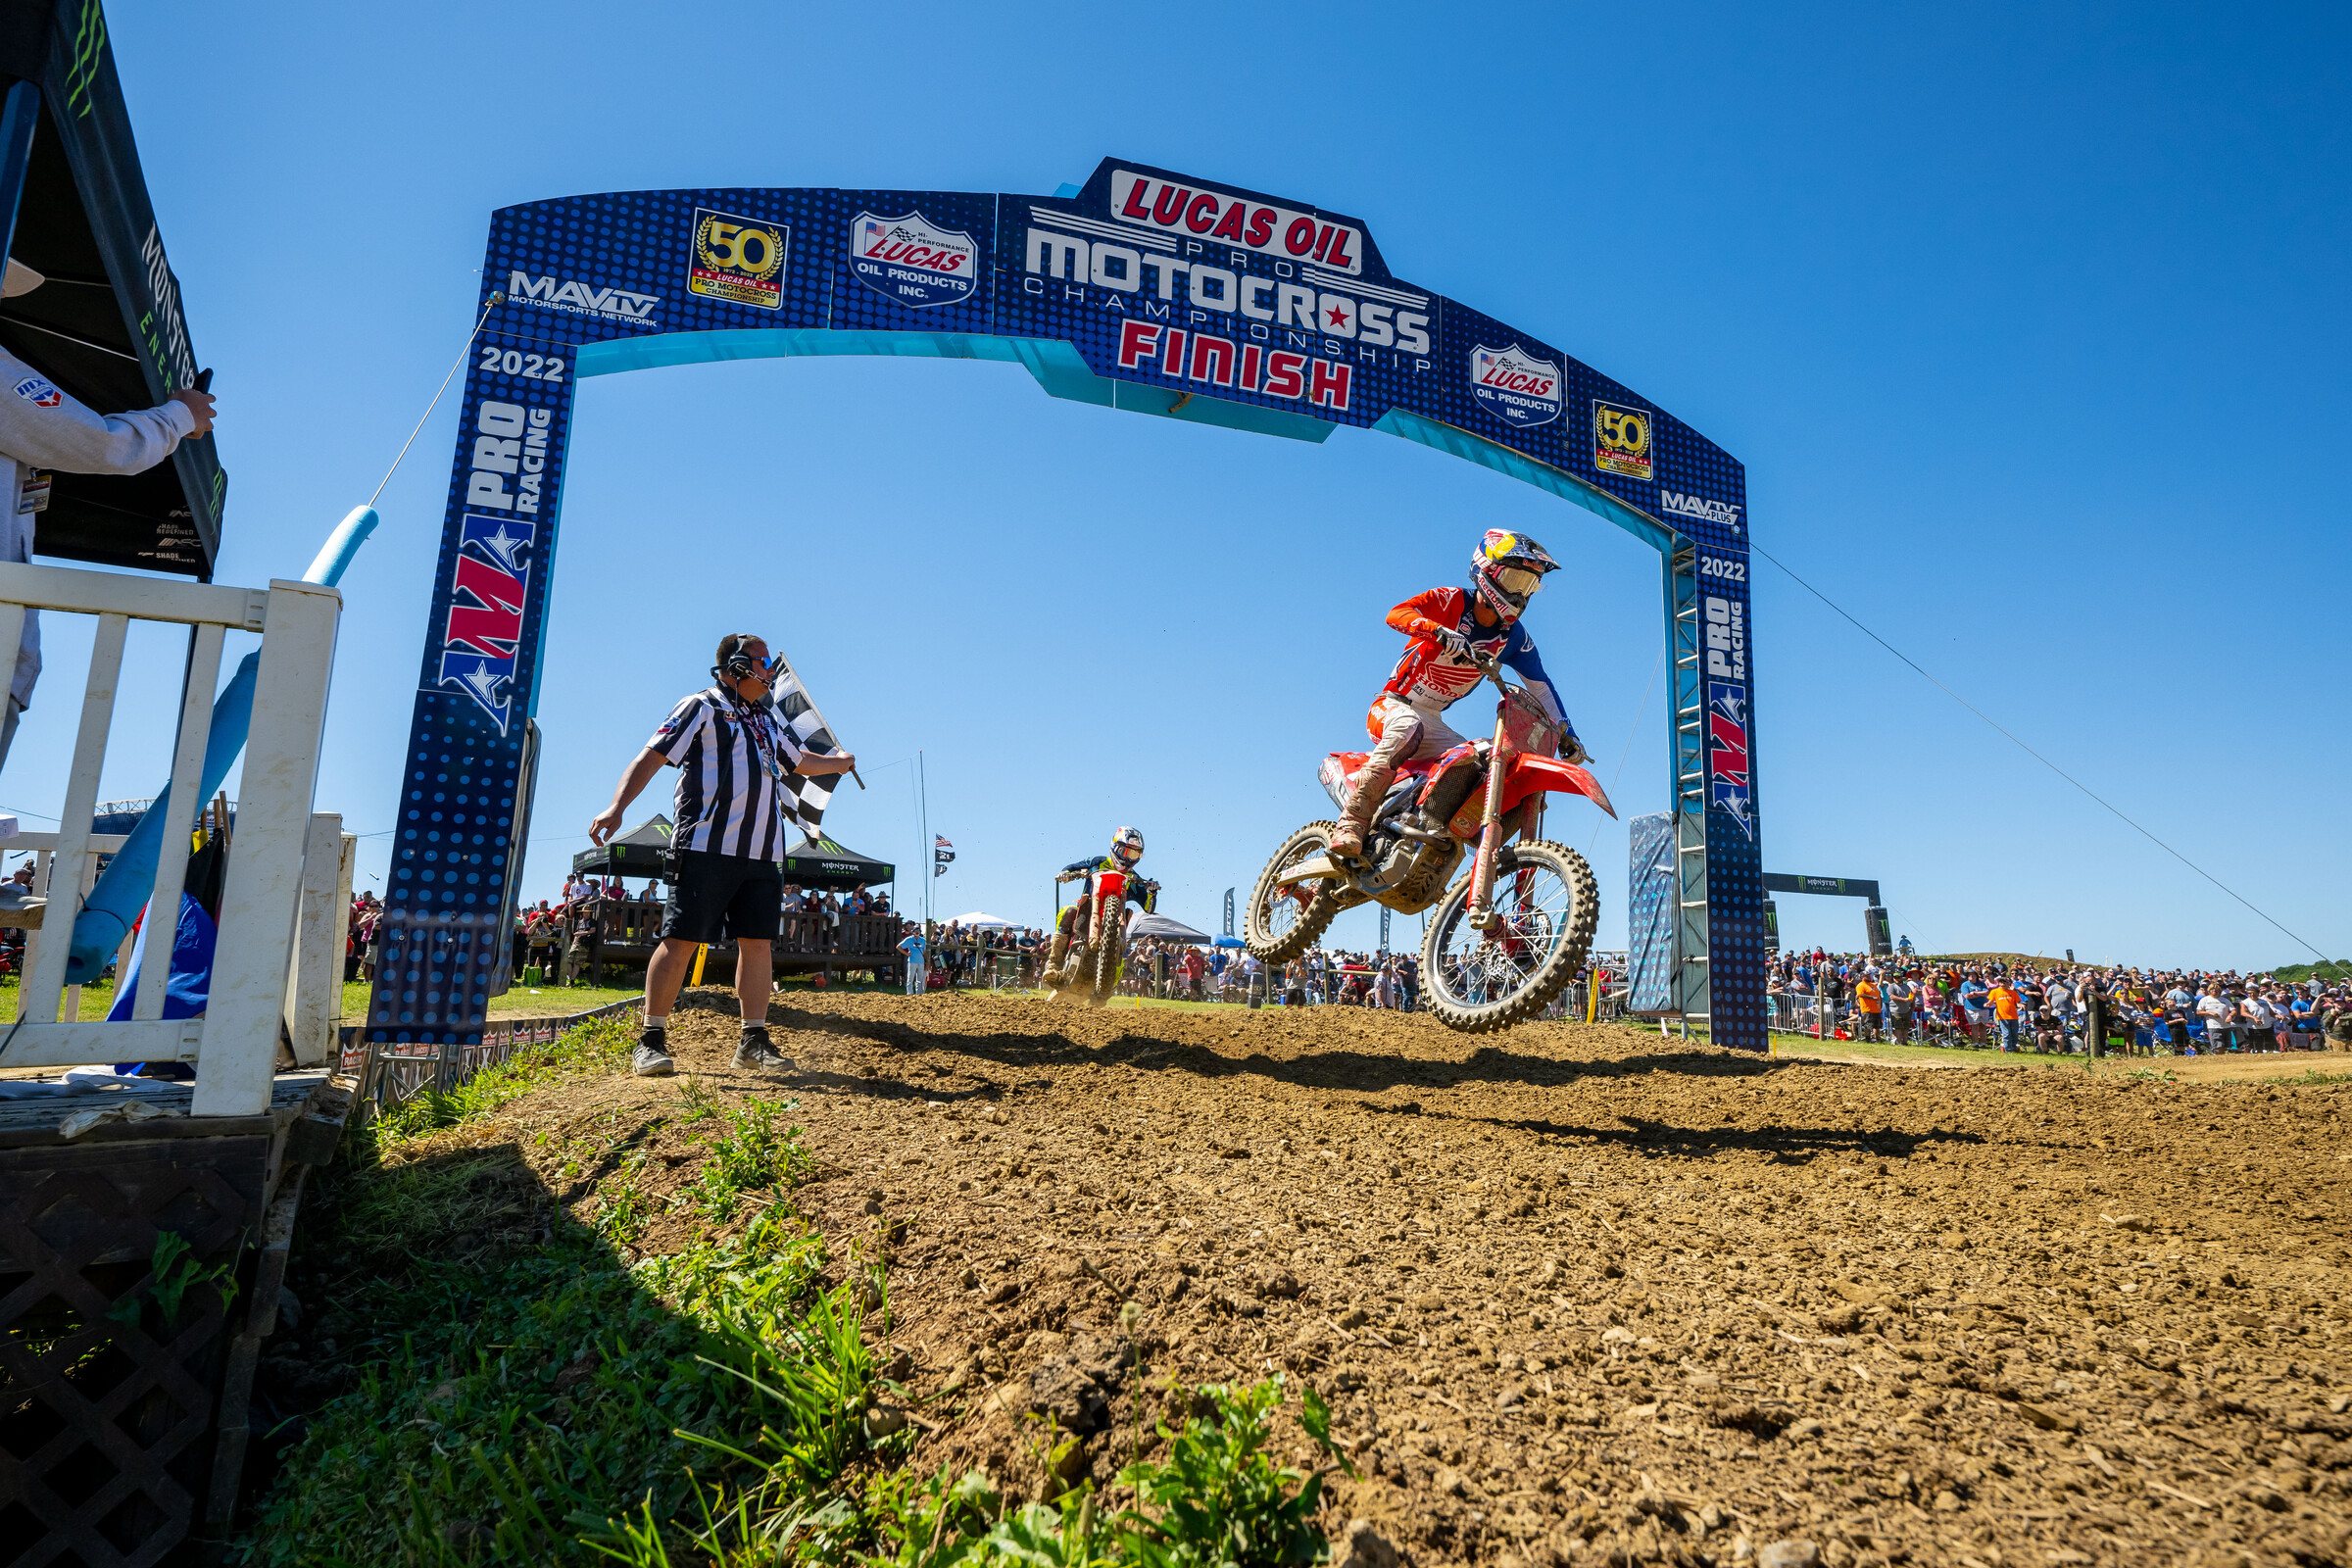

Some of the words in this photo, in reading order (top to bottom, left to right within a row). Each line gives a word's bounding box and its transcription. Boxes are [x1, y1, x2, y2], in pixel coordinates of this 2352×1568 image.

[1121, 178, 1277, 248] LUCAS
[1285, 215, 1352, 268] OIL
[706, 220, 776, 272] 50
[864, 239, 967, 271] LUCAS
[917, 239, 970, 253] PERFORMANCE
[1186, 241, 1294, 278] PRO
[695, 277, 715, 287] PRO
[717, 281, 777, 299] MOTOCROSS
[716, 273, 744, 284] LUCAS
[857, 263, 883, 276] OIL
[888, 268, 968, 291] PRODUCTS
[1026, 227, 1431, 355] MOTOCROSS
[509, 270, 661, 318] MAVTV
[706, 287, 765, 303] CHAMPIONSHIP
[508, 295, 599, 317] MOTORSPORTS
[601, 311, 658, 327] NETWORK
[1024, 277, 1431, 372] CHAMPIONSHIP
[140, 311, 174, 394] ENER
[479, 346, 565, 383] 2022
[1117, 318, 1352, 412] FINISH
[1481, 368, 1553, 396] LUCAS
[1517, 367, 1555, 379] PERFORMANCE
[1476, 388, 1495, 400] OIL
[1498, 392, 1555, 414] PRODUCTS
[1603, 410, 1645, 451] 50
[466, 400, 526, 511] PRO
[515, 408, 552, 514] RACING
[1611, 453, 1628, 462] LUCAS
[1613, 460, 1649, 472] MOTOCROSS
[1661, 489, 1742, 515] MAVTV
[1711, 511, 1732, 523] PLUS
[1701, 556, 1745, 581] 2022
[1705, 596, 1732, 679] PRO
[1730, 601, 1744, 681] RACING
[821, 861, 859, 872] MONSTER
[1807, 878, 1838, 887] MONSTER
